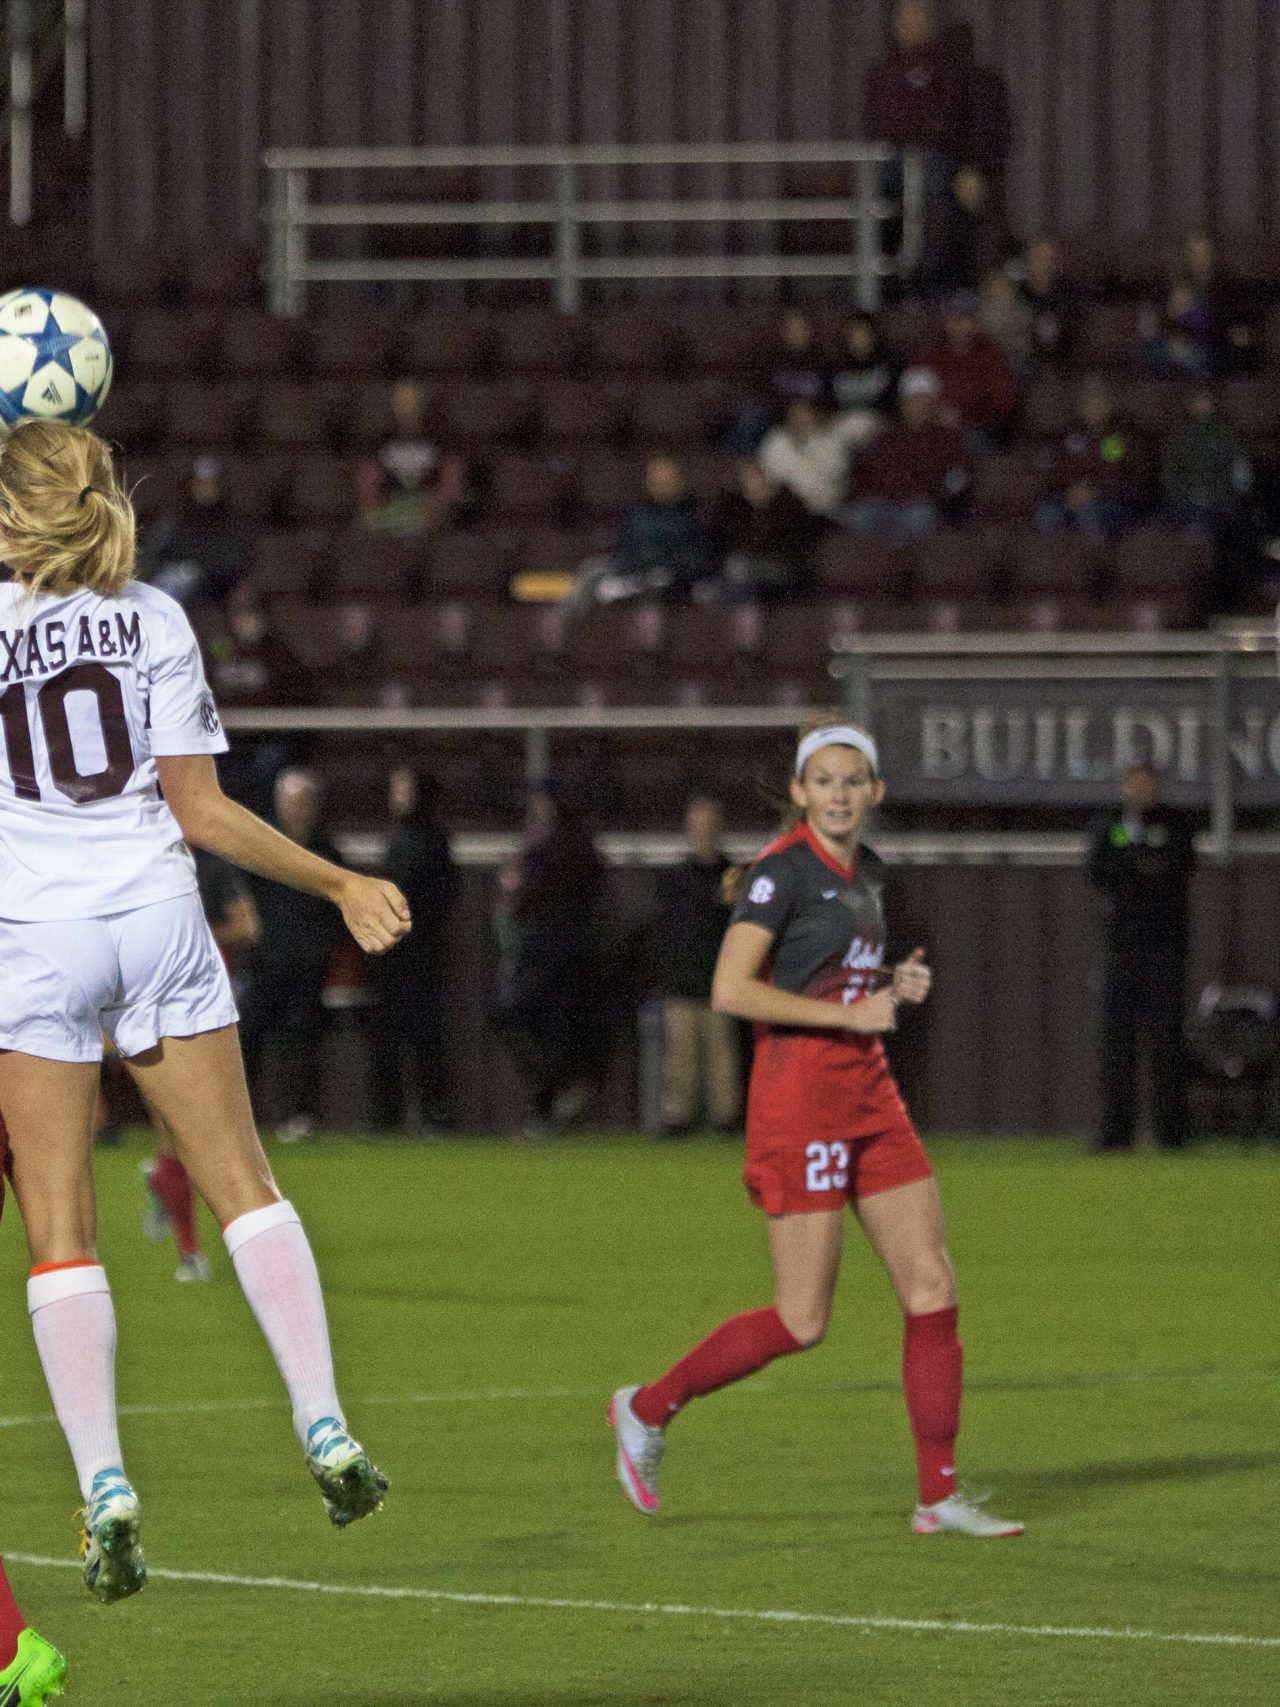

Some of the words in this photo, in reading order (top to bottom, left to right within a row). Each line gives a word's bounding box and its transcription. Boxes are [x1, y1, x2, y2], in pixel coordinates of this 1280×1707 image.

[77, 611, 141, 658] A&M
[920, 704, 1280, 783] BUILDIN
[805, 1140, 849, 1192] 23
